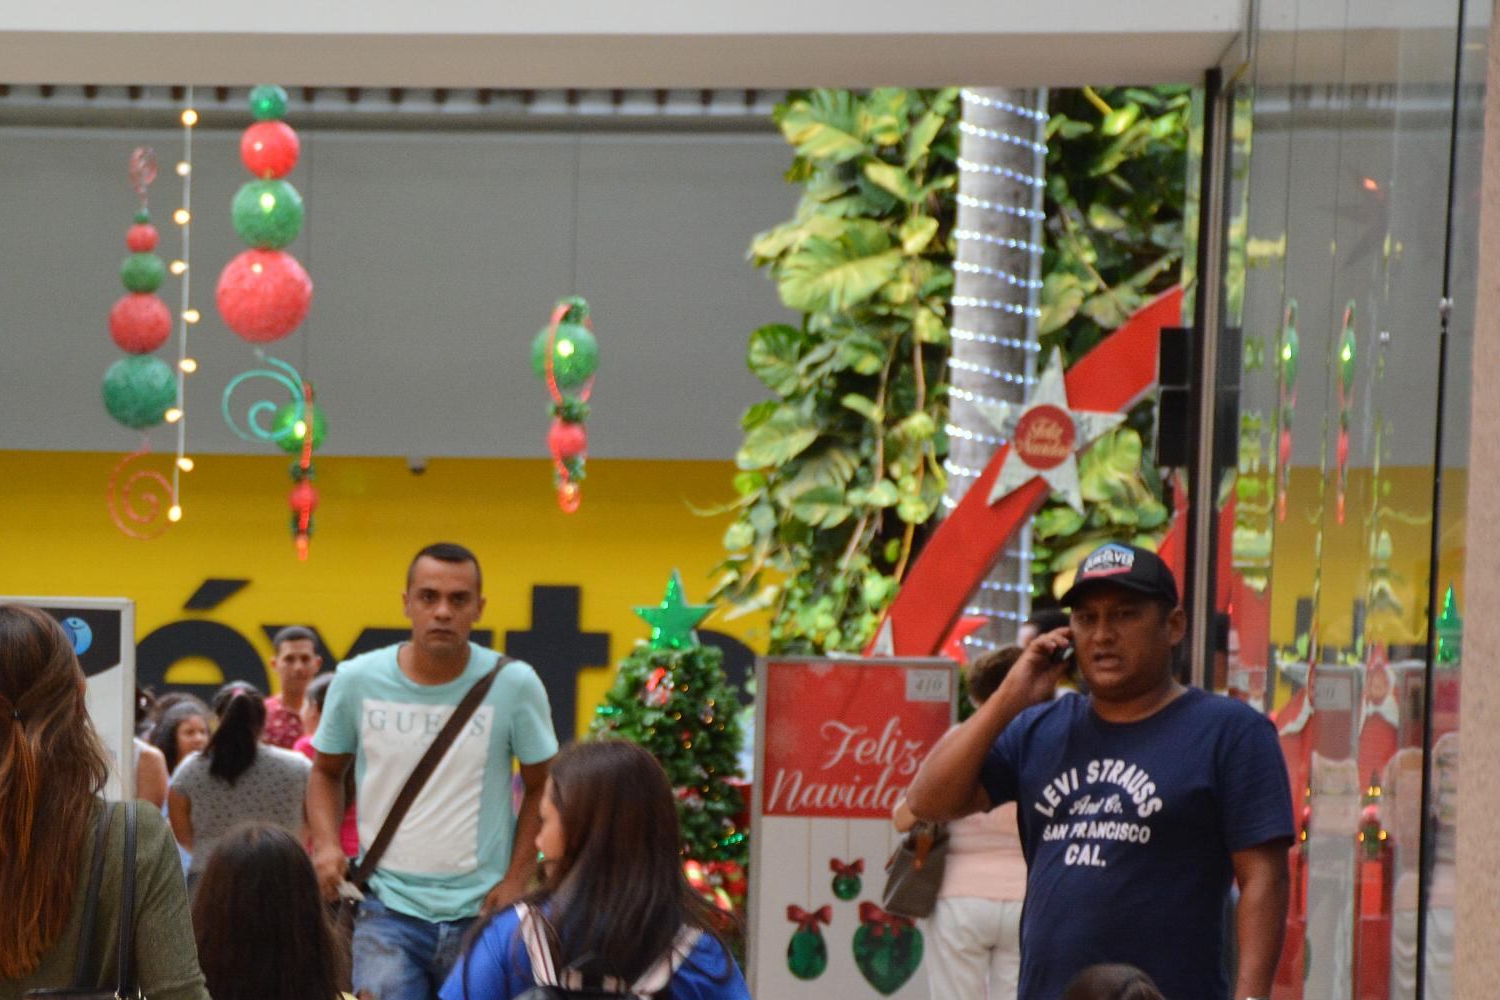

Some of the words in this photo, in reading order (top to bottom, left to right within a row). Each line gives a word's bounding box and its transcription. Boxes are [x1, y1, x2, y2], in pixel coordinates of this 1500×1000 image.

[367, 708, 486, 737] GUES
[819, 715, 923, 775] Feliz
[767, 765, 908, 812] Navida
[1034, 767, 1079, 818] LEVI
[1086, 758, 1163, 818] STRAUSS
[1043, 823, 1069, 841] SAN
[1068, 820, 1151, 844] FRANCISCO
[1064, 843, 1107, 867] CAL.
